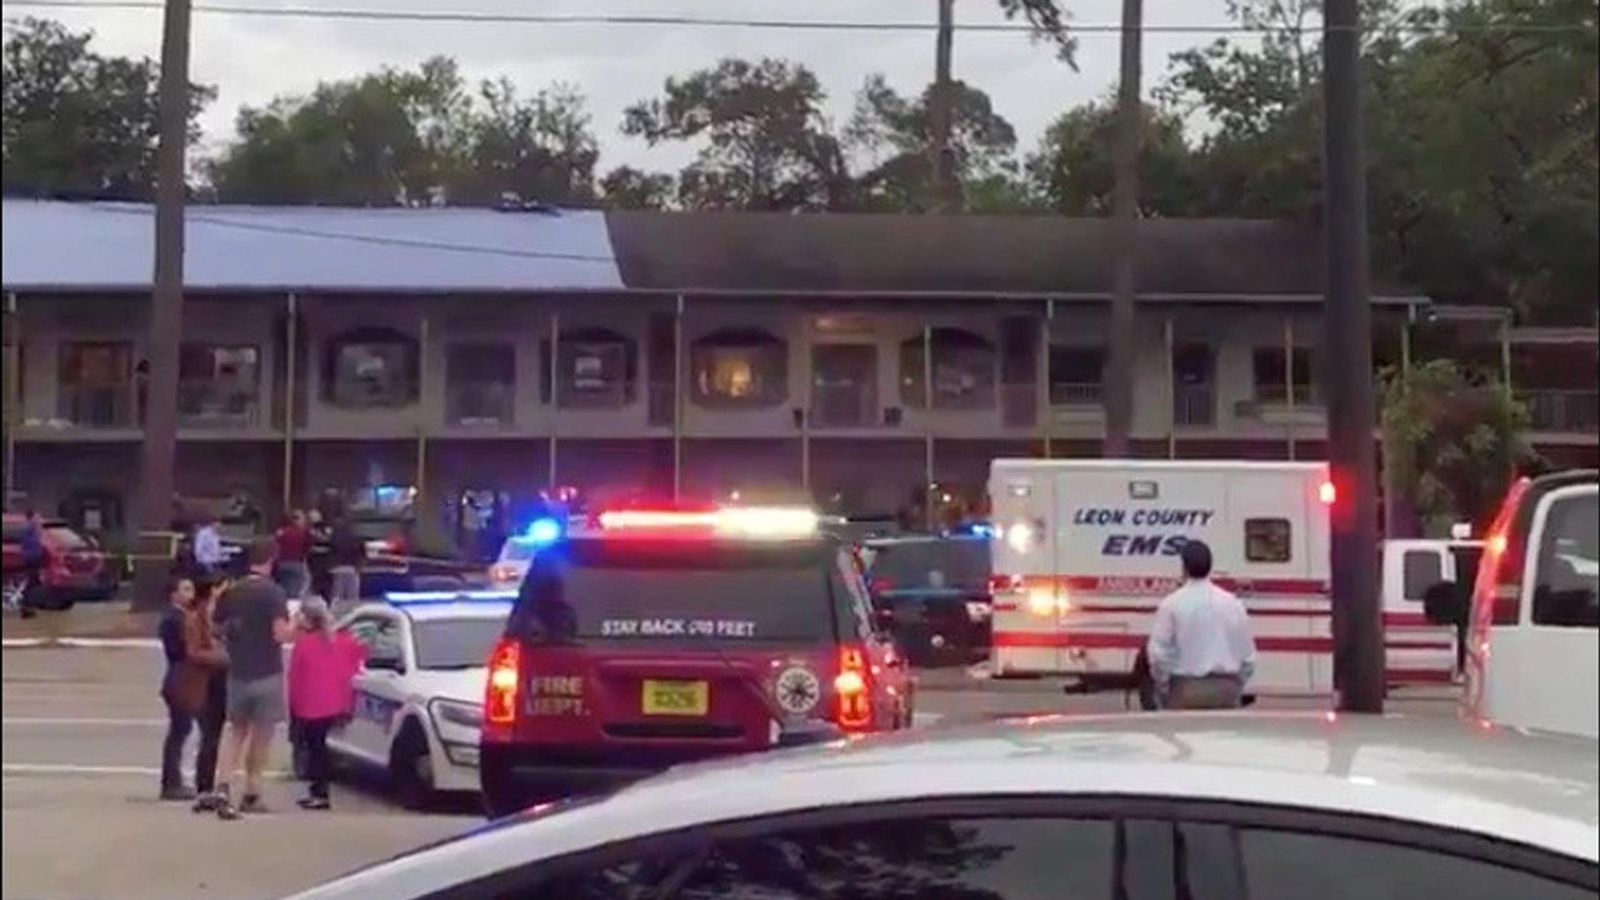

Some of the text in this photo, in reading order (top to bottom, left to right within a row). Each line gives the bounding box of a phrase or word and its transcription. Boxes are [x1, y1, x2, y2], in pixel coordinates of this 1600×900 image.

[1073, 508, 1215, 527] LEON COUNTY
[1101, 533, 1190, 556] EMS
[639, 618, 685, 635] BACK
[717, 619, 756, 637] FEET
[531, 676, 583, 694] FIRE
